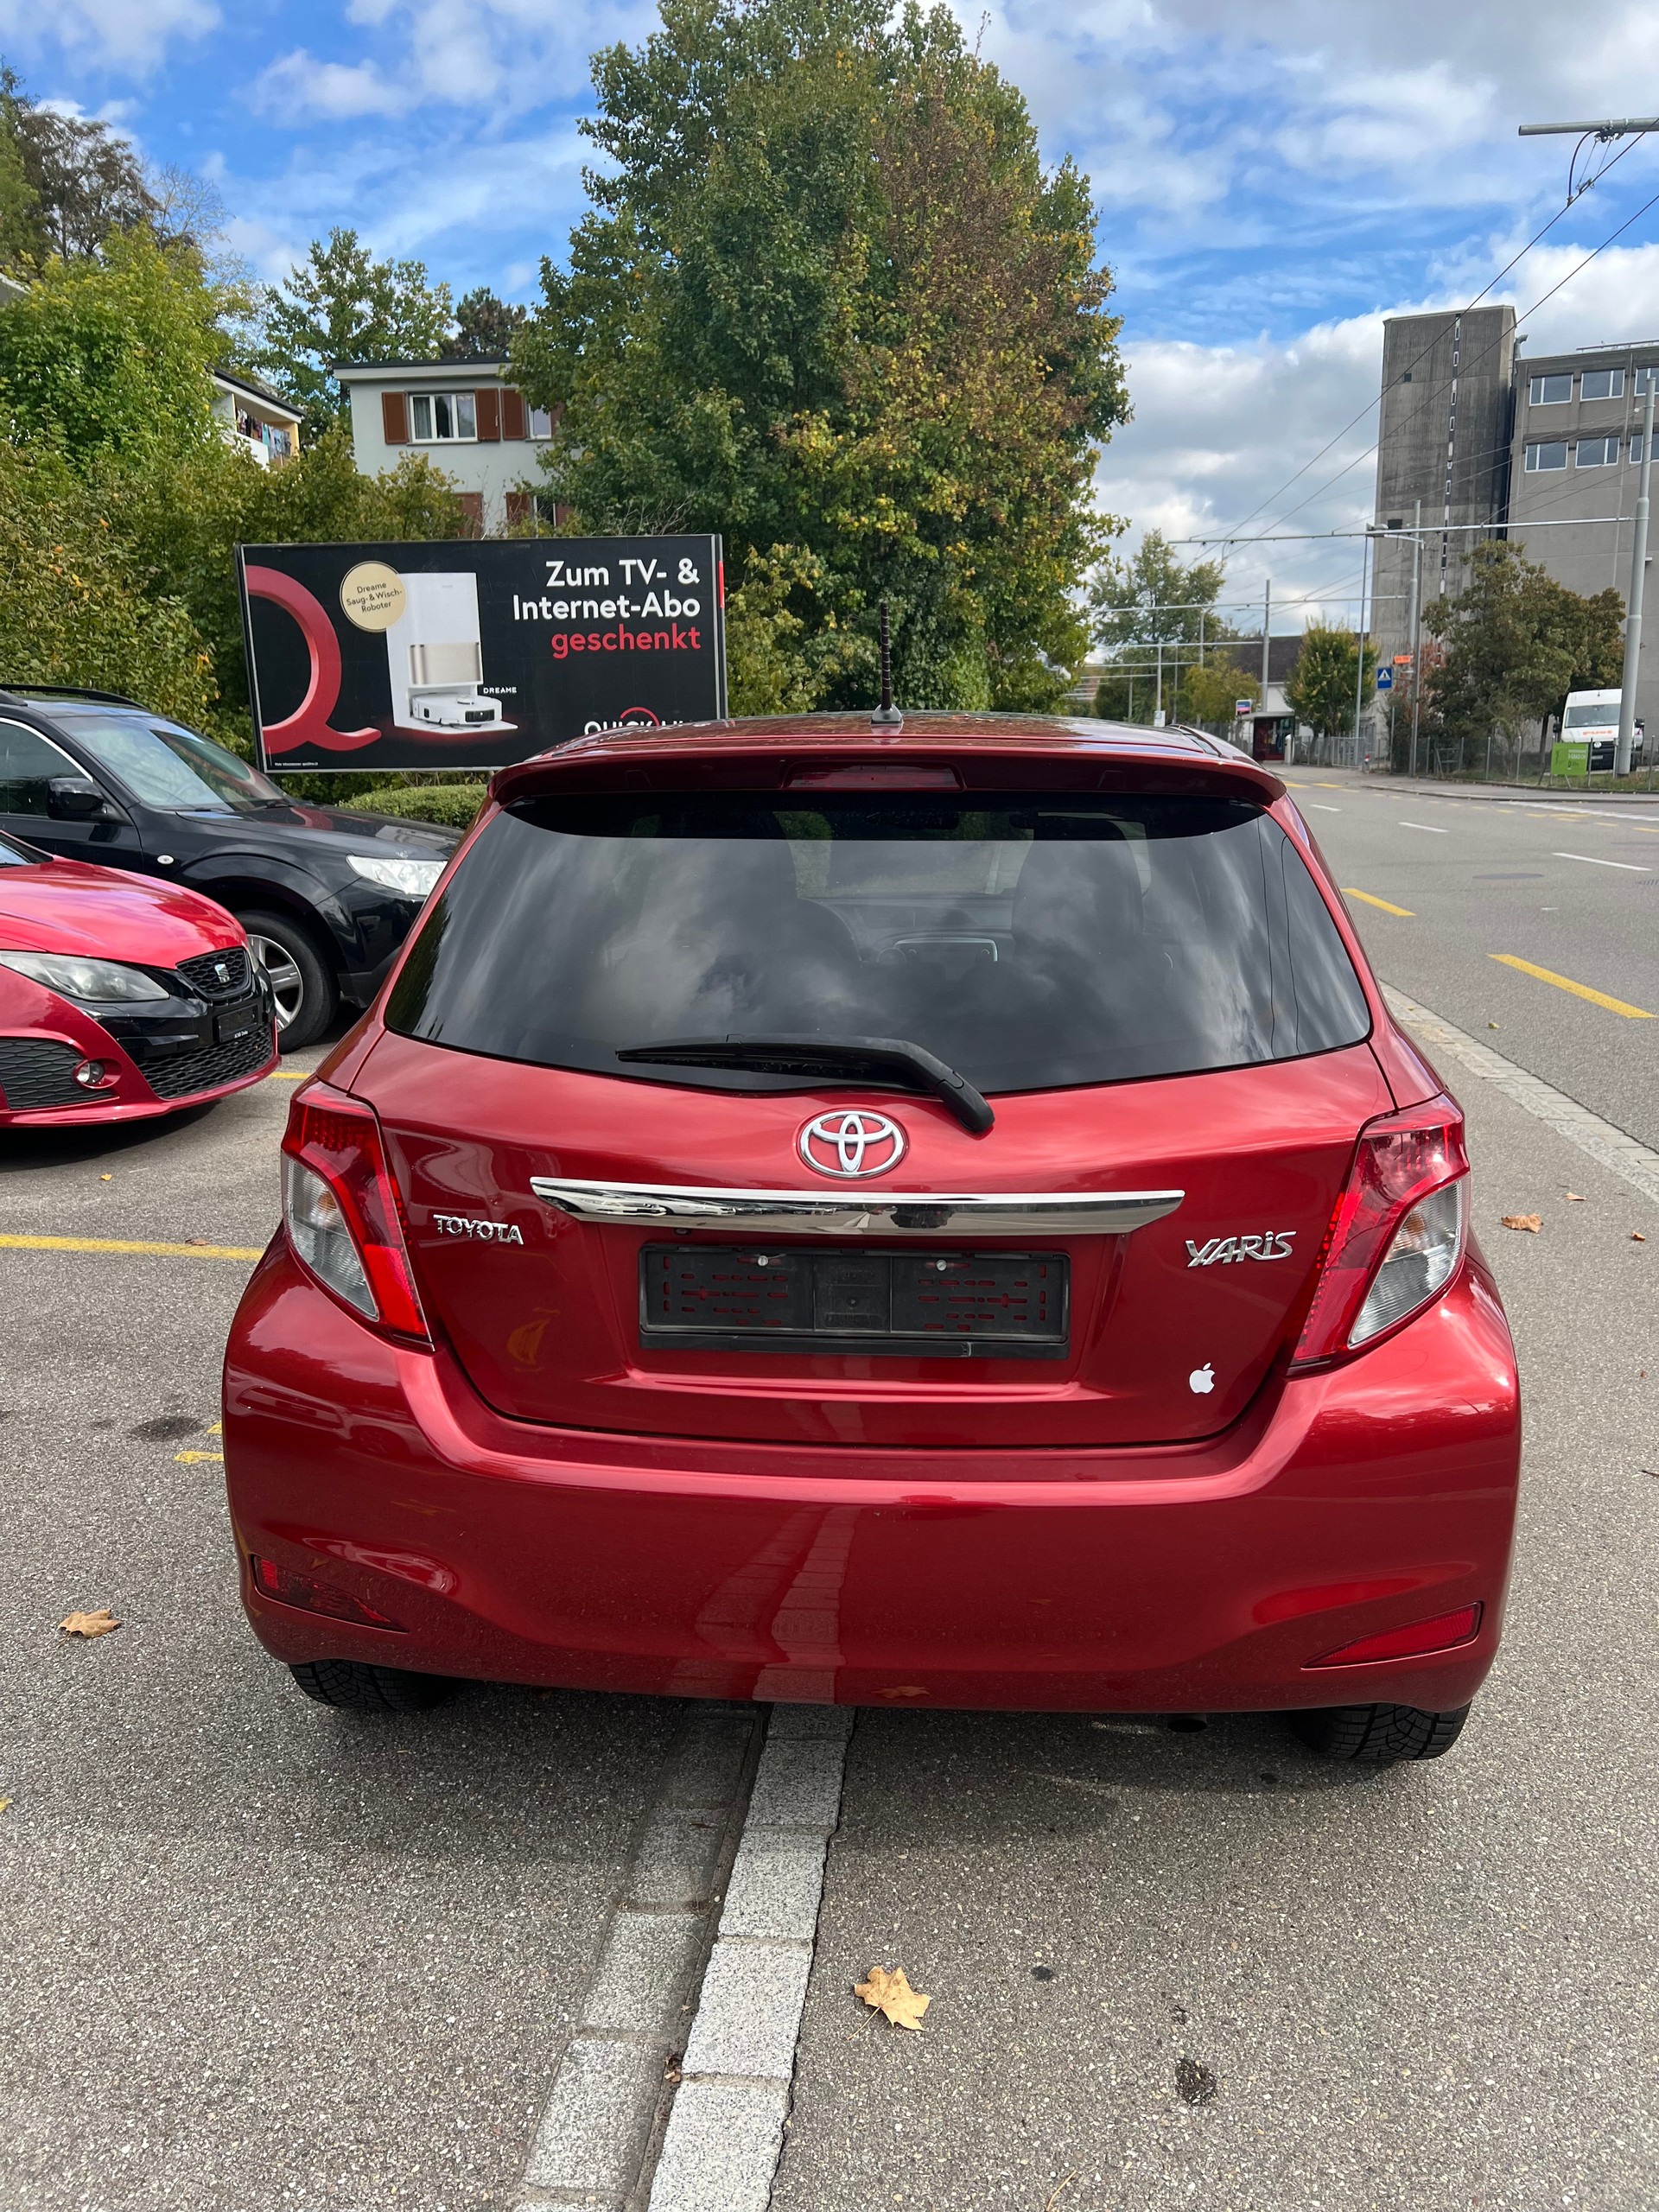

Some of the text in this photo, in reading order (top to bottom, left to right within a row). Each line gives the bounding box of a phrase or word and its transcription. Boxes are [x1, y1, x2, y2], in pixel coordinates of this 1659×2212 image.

[545, 557, 701, 587] Zum TV- &
[356, 582, 387, 594] Dreame
[361, 601, 391, 613] Roboter
[513, 589, 701, 620] Internet-Abo
[551, 622, 701, 659] geschenkt
[433, 1214, 524, 1245] TOYOTA
